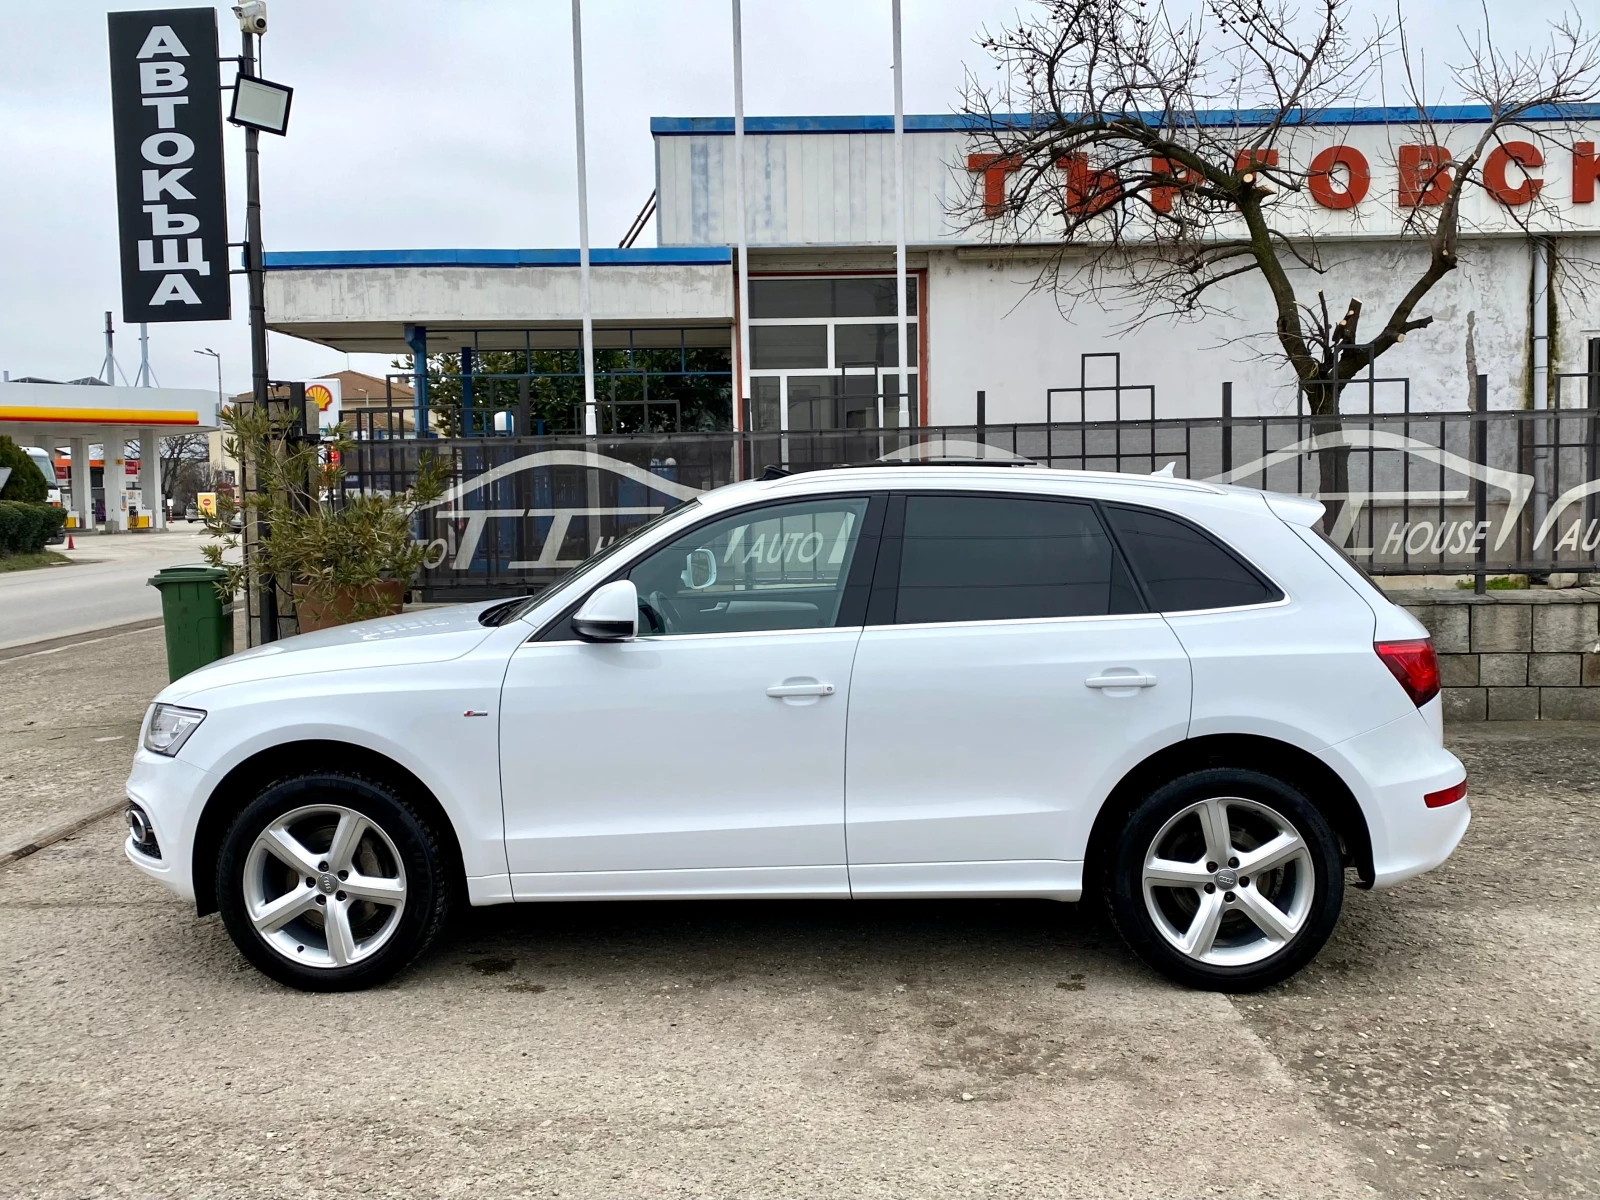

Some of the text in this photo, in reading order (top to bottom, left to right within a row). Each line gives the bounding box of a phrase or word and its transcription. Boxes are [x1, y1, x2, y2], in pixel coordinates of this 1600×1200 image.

[136, 25, 211, 306] АВТОКЪЩА
[742, 532, 824, 564] AUTO
[1380, 520, 1492, 555] HOUSE
